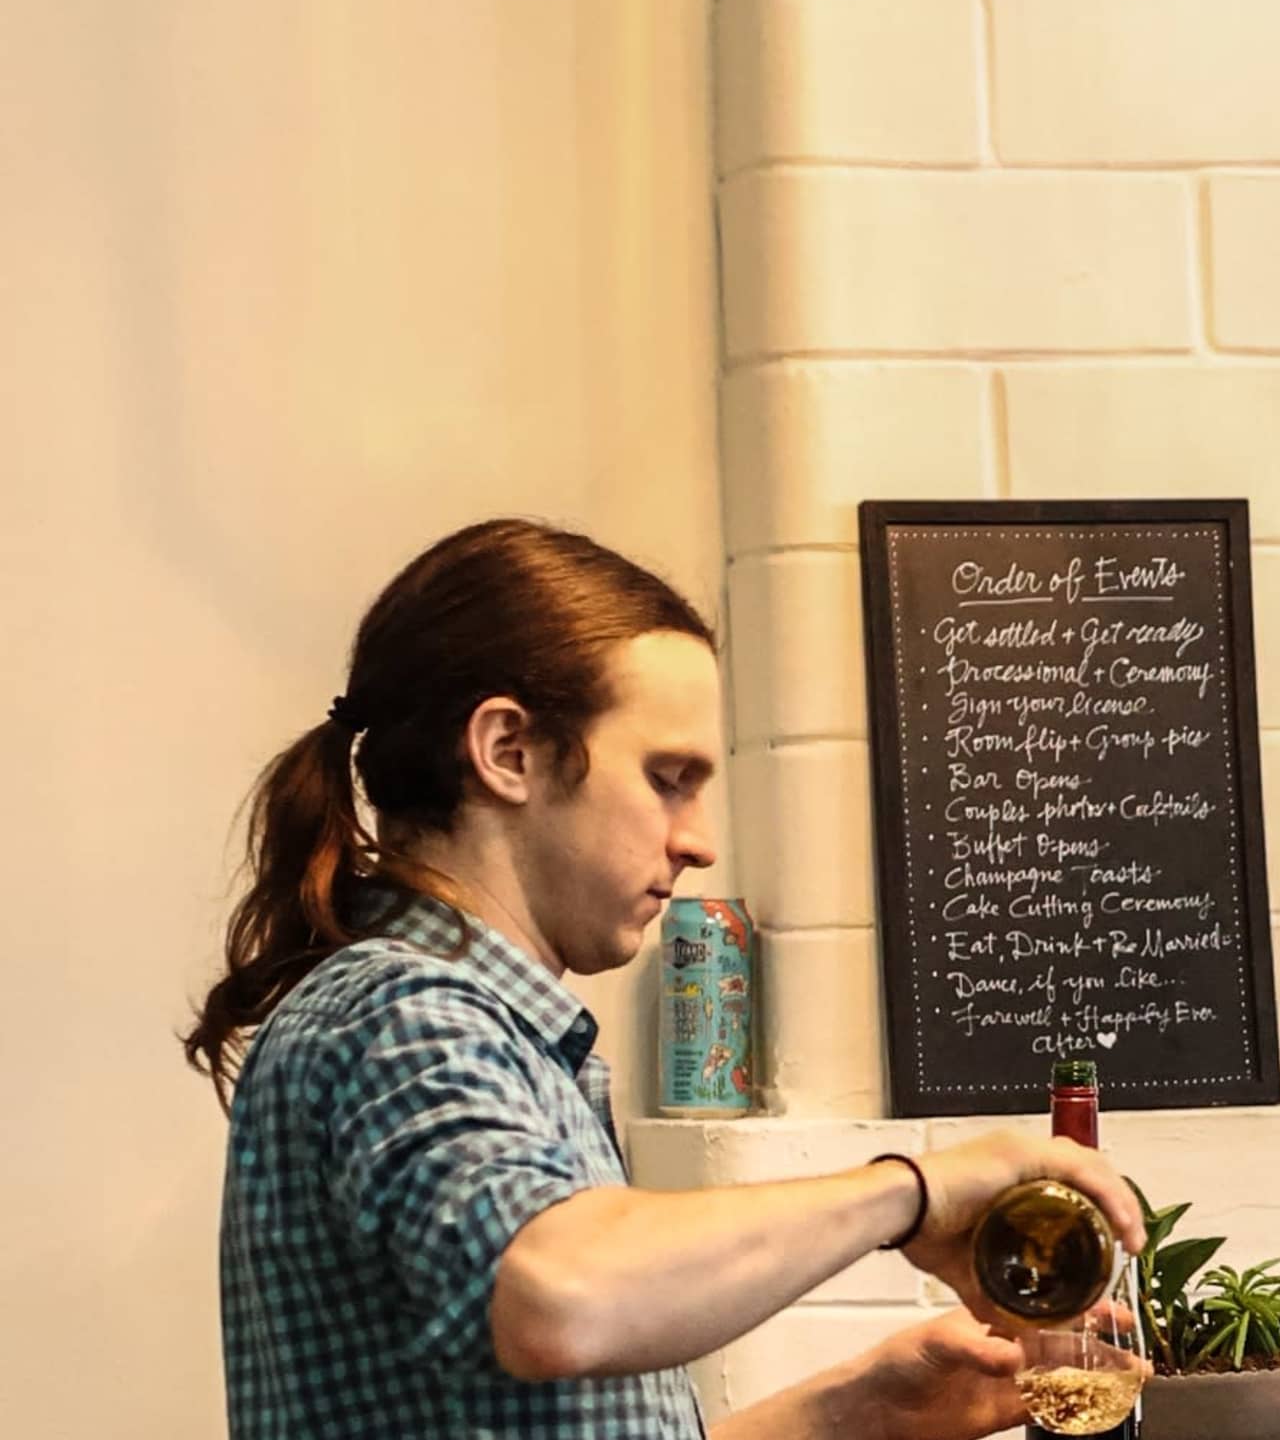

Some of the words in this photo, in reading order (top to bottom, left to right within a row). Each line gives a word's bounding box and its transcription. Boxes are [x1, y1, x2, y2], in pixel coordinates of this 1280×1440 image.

[952, 561, 1042, 595] Order
[1050, 557, 1085, 604] of
[933, 617, 980, 656] Get
[984, 618, 1058, 647] settled
[1080, 617, 1124, 656] Get
[1126, 617, 1204, 657] ready
[937, 655, 1089, 696] Processional
[1109, 657, 1214, 699] Ceremony
[948, 692, 1001, 728] Sign
[1006, 696, 1065, 726] your
[945, 726, 1014, 758] Room
[1014, 724, 1067, 763] flip
[1086, 725, 1155, 761] Group
[948, 763, 1003, 792] Bar
[945, 794, 1030, 832] Couples
[947, 831, 1028, 864] Buffet
[944, 861, 1063, 894] Champagne
[942, 893, 1001, 921] Cake
[1008, 894, 1093, 929] Cutting
[1100, 891, 1216, 920] Ceremony
[1005, 930, 1089, 960] Drink
[1027, 965, 1056, 1003] if
[1061, 975, 1105, 1005] you
[951, 1002, 1051, 1036] Farewell
